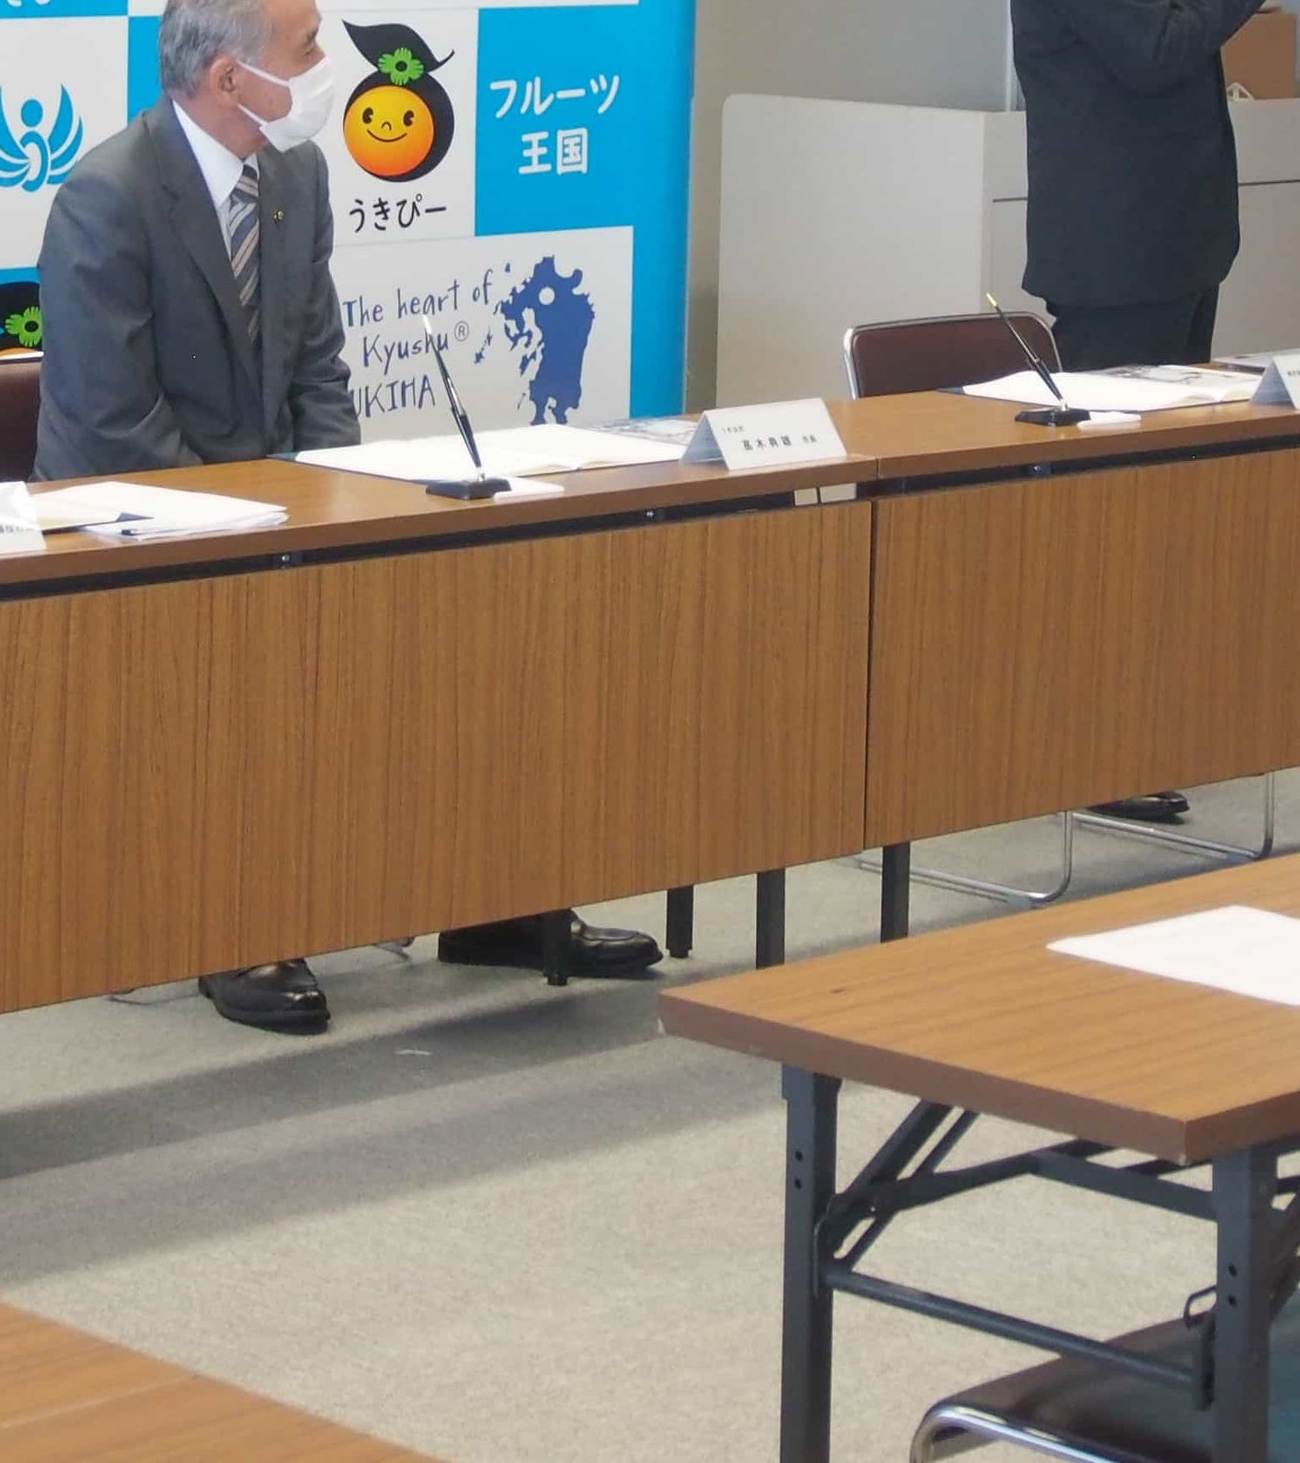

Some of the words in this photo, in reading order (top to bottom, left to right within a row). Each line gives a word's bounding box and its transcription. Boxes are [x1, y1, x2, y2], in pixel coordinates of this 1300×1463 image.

[491, 76, 618, 117] フルーツ
[520, 128, 587, 174] 王国
[350, 194, 446, 232] うきぴー
[342, 295, 384, 327] The
[397, 279, 460, 319] heart
[472, 269, 494, 305] of
